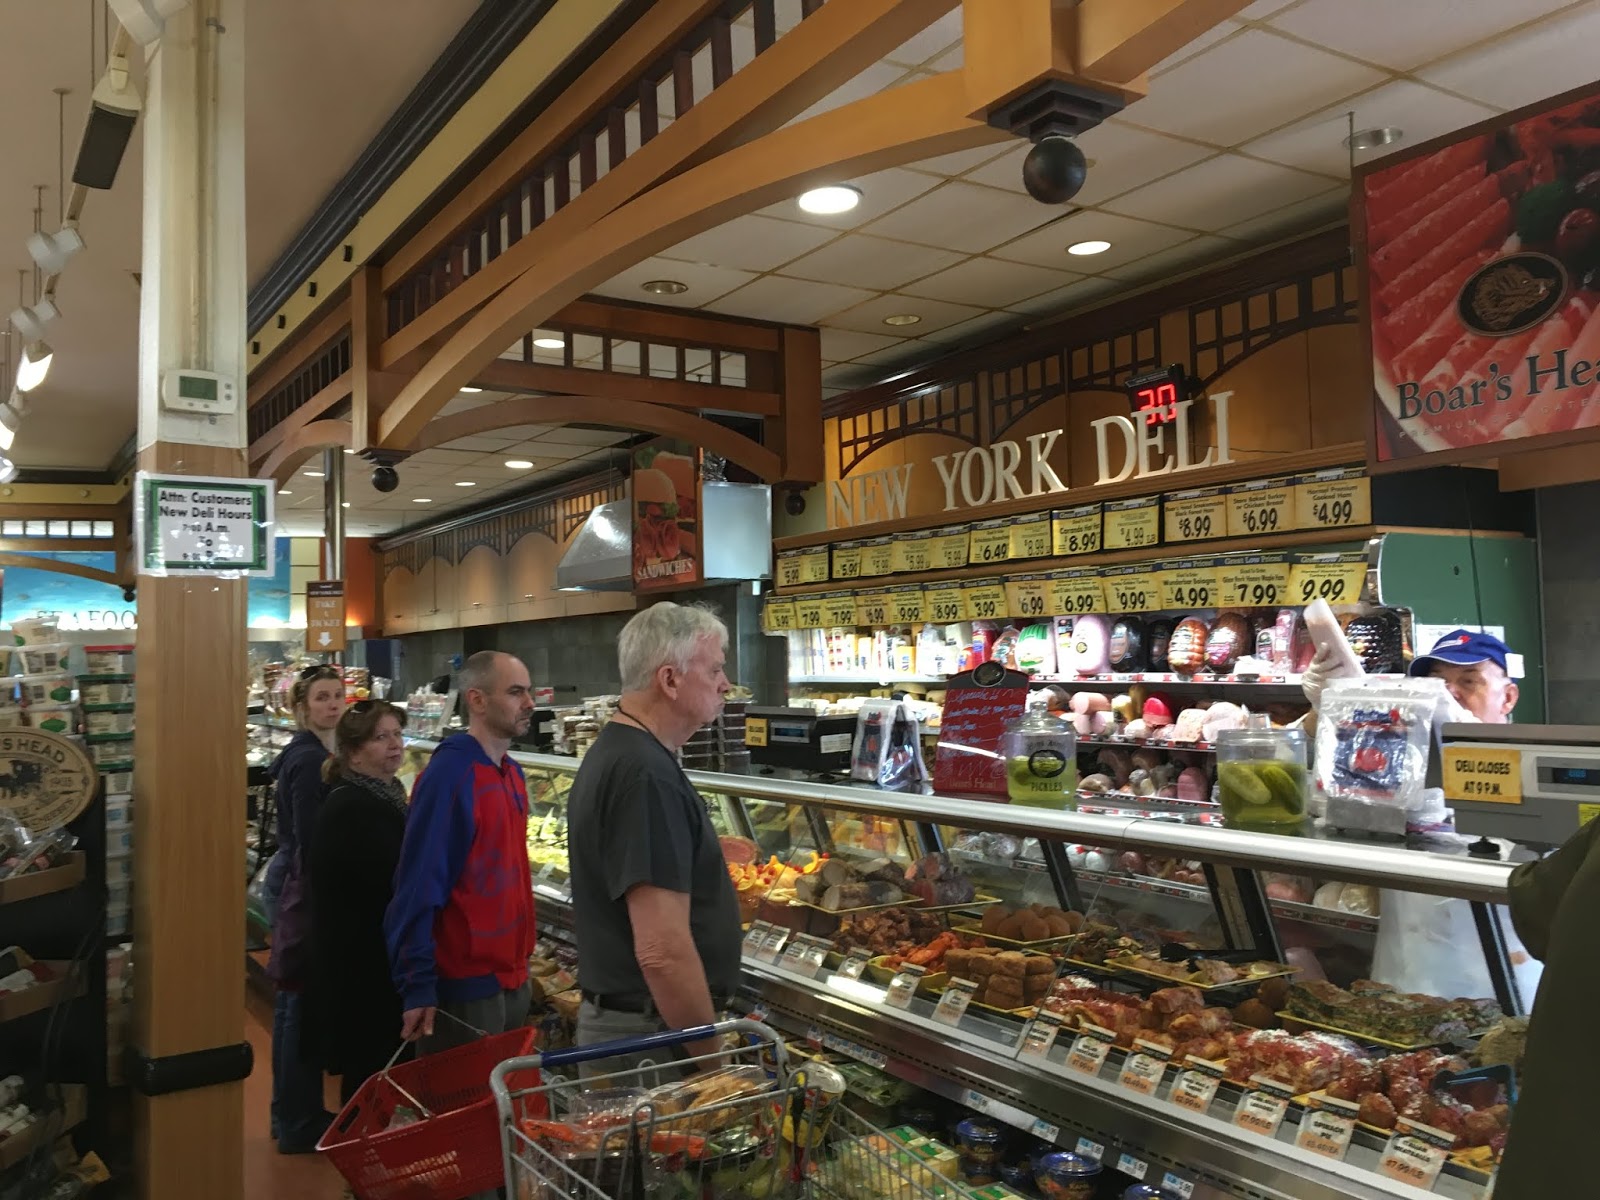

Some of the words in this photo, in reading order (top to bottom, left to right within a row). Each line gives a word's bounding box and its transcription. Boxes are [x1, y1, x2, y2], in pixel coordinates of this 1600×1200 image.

[1396, 362, 1513, 421] Boar's
[1138, 383, 1177, 425] 30
[830, 462, 914, 530] NEW
[931, 429, 1070, 511] YORK
[1090, 390, 1235, 486] DELI
[191, 491, 252, 506] Customers
[160, 505, 188, 517] New
[191, 507, 215, 519] Deli
[218, 508, 252, 520] Hours
[1243, 507, 1278, 532] $6.99
[1312, 499, 1352, 525] $4.99
[1179, 515, 1211, 538] $8.99
[637, 558, 693, 580] SANDWICHES
[1224, 557, 1244, 565] Great
[1245, 556, 1260, 564] Low
[16, 738, 66, 763] HEAD
[1455, 760, 1476, 773] DELI
[1477, 761, 1511, 775] CLOSES
[1031, 781, 1063, 792] PICKLES
[1463, 781, 1476, 794] AT
[1477, 781, 1483, 795] 9
